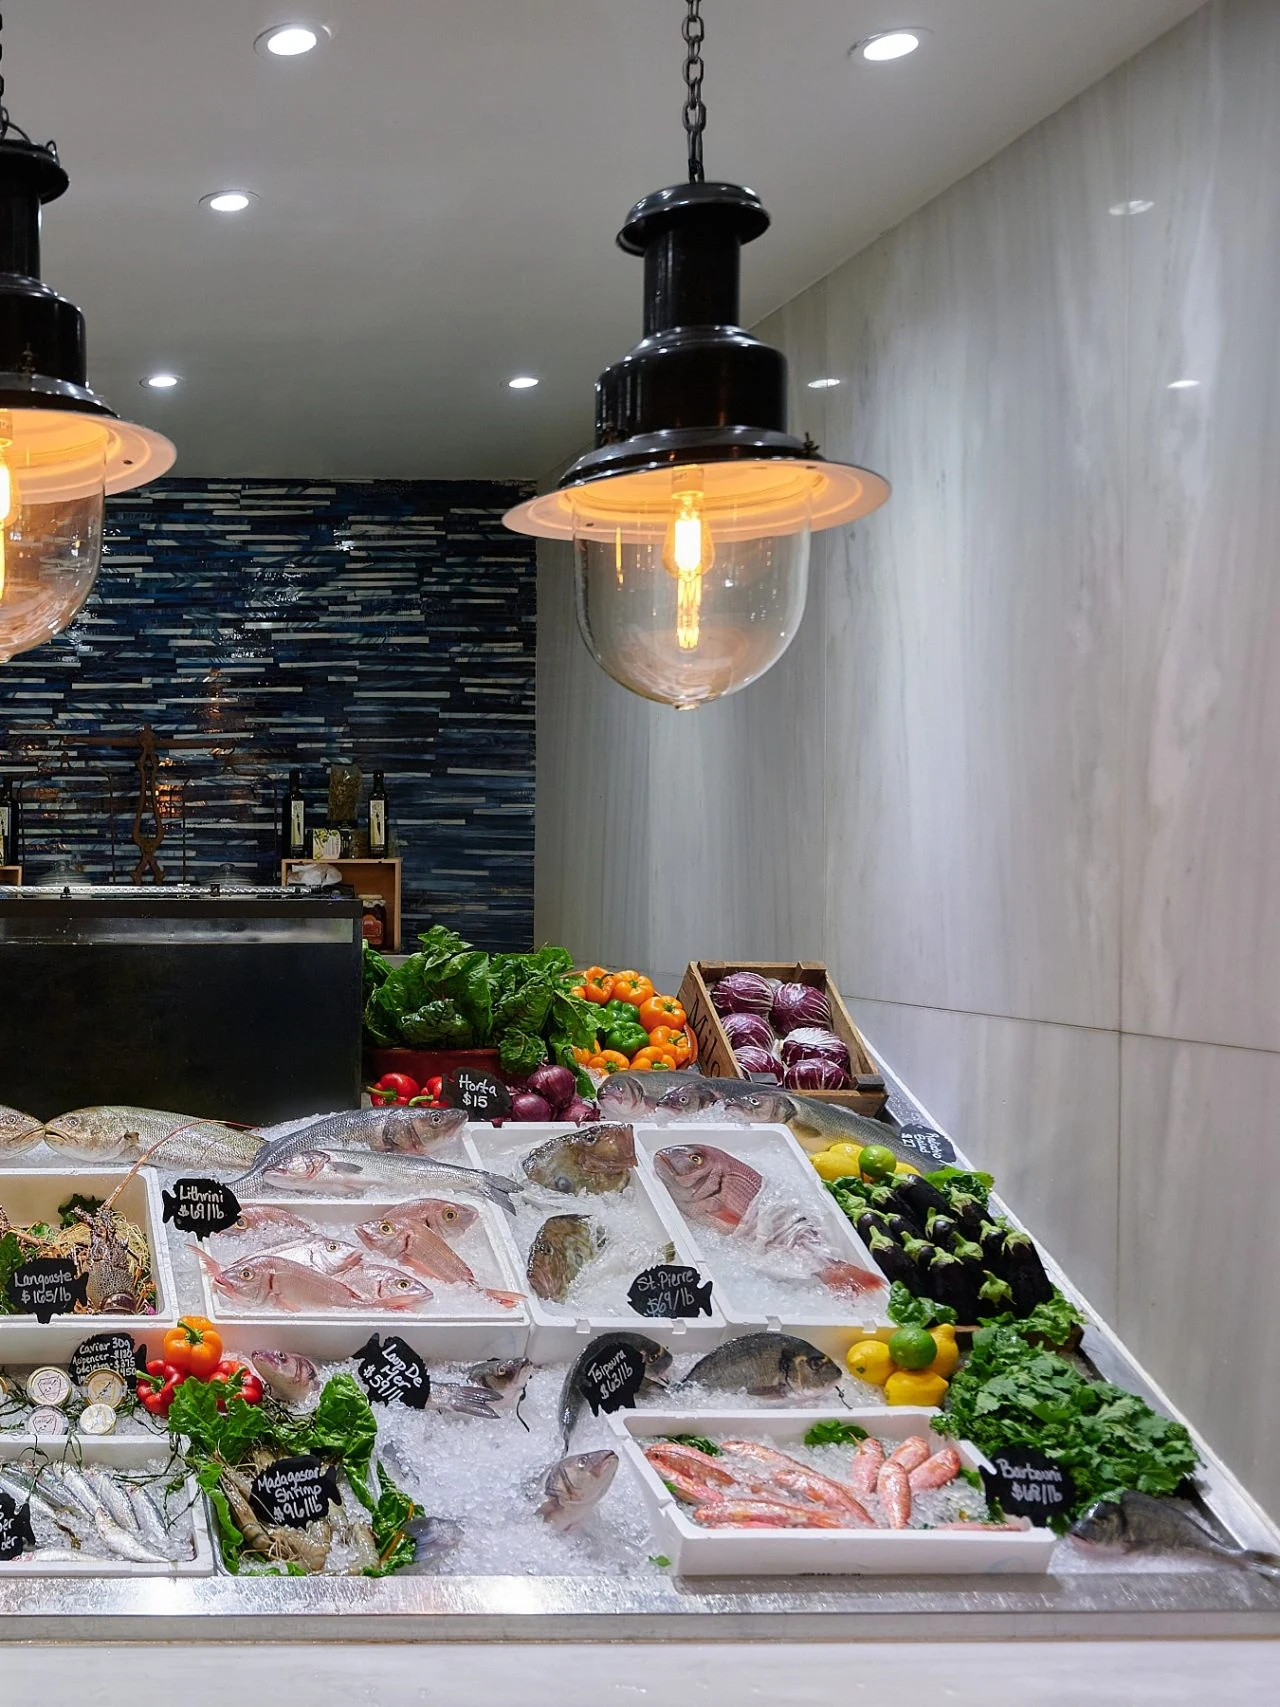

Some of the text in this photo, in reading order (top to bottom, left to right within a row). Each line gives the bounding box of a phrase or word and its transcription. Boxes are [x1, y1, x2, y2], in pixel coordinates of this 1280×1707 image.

[459, 1074, 497, 1097] Horta
[462, 1091, 488, 1108] $15
[179, 1184, 224, 1203] Lithrini
[177, 1203, 225, 1221] $69/lb
[79, 1342, 111, 1355] Caviar
[600, 1362, 633, 1400] $63/lb
[257, 1467, 320, 1493] Madagascar
[274, 1485, 322, 1503] Shrimp
[273, 1495, 323, 1522] $96/lb
